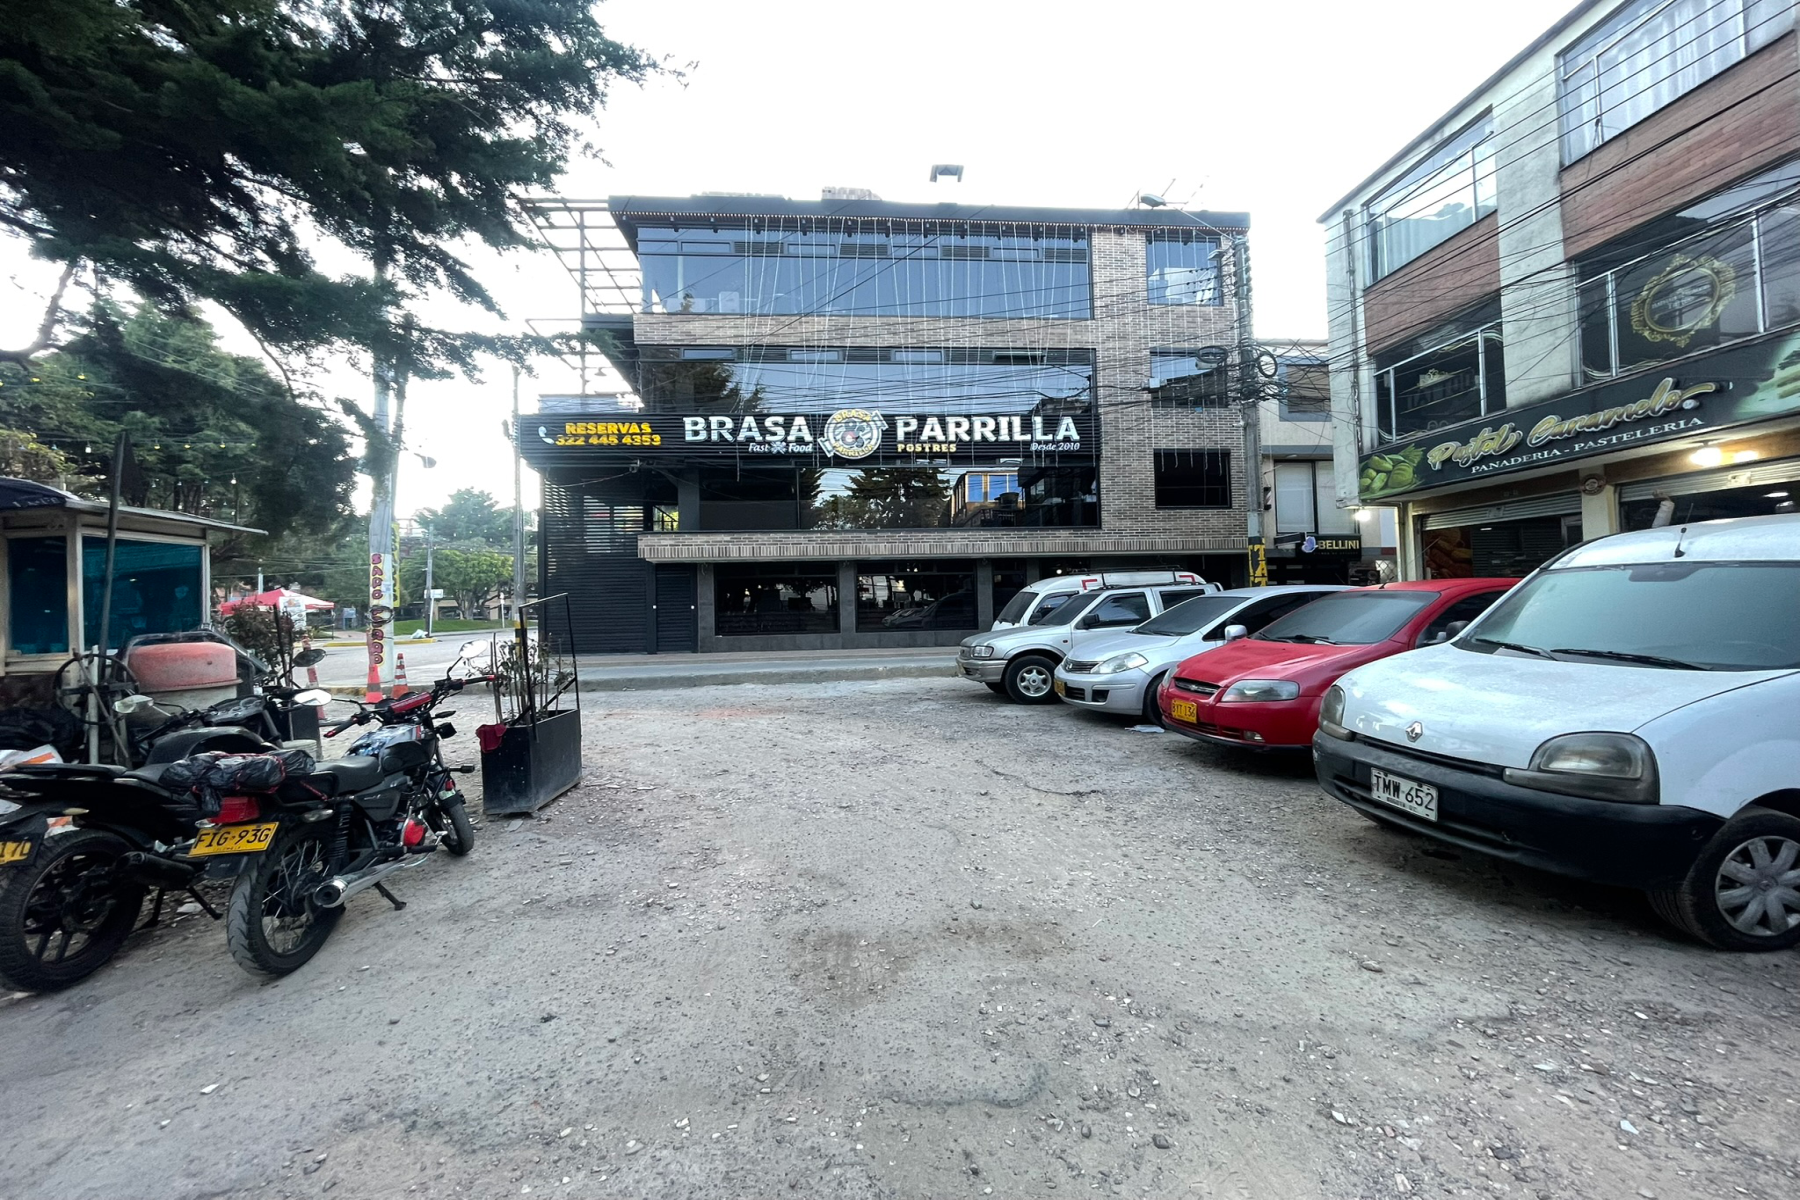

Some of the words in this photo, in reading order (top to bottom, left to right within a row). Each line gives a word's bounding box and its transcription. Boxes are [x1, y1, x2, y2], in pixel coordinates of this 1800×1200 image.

[565, 422, 652, 435] RESERVAS
[682, 415, 813, 444] BRASA
[895, 416, 1081, 443] PARRILLA
[1427, 422, 1523, 470] Pastel
[1527, 377, 1716, 448] Caramelo
[555, 434, 585, 446] 322
[588, 434, 619, 446] 445
[621, 434, 662, 446] 4353
[1471, 448, 1562, 474] PANADERIA
[1573, 417, 1705, 452] PASTELERIA
[748, 442, 769, 453] Fast
[788, 442, 813, 453] Food
[897, 443, 957, 453] POSTRES
[1030, 442, 1057, 452] Desde
[1057, 441, 1081, 451] 2010
[1318, 540, 1360, 550] BELLINI
